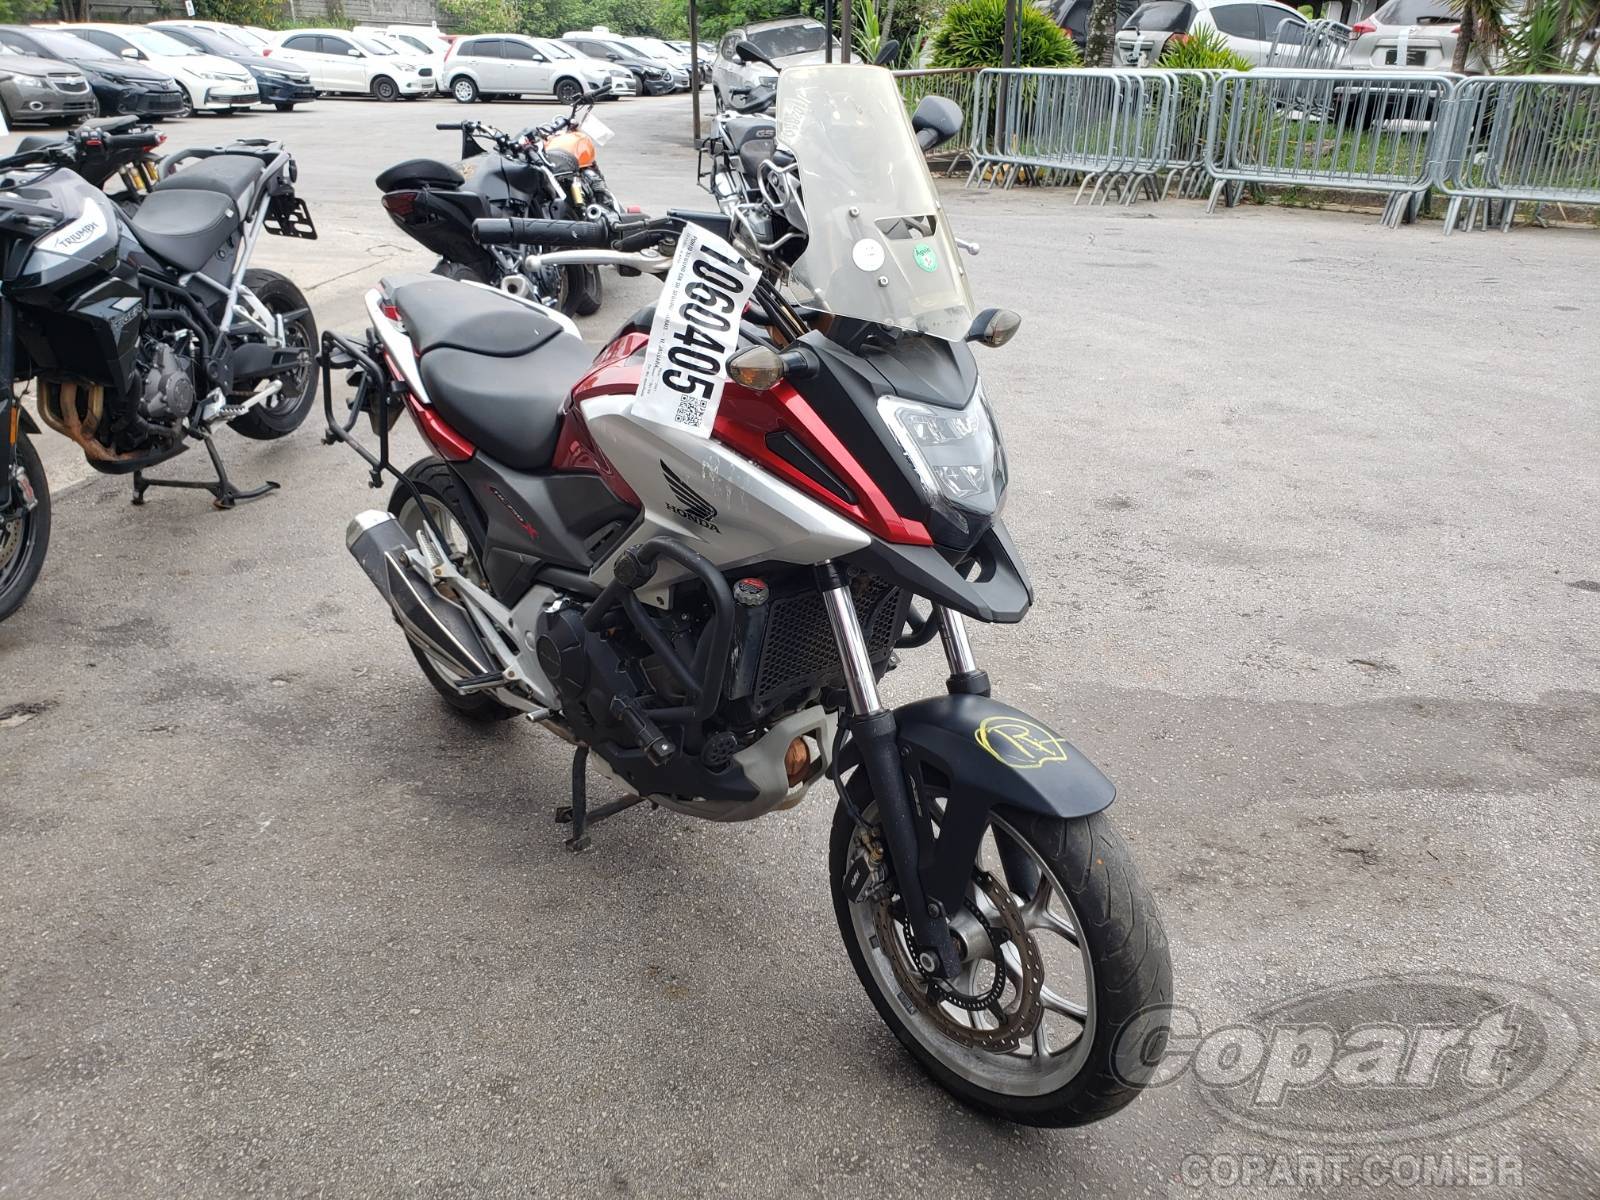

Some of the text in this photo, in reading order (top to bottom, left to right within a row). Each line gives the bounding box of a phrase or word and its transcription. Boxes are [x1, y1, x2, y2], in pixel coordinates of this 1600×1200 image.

[59, 221, 99, 248] TRIUMPH
[662, 245, 750, 400] 1060405
[664, 501, 723, 535] HONDA
